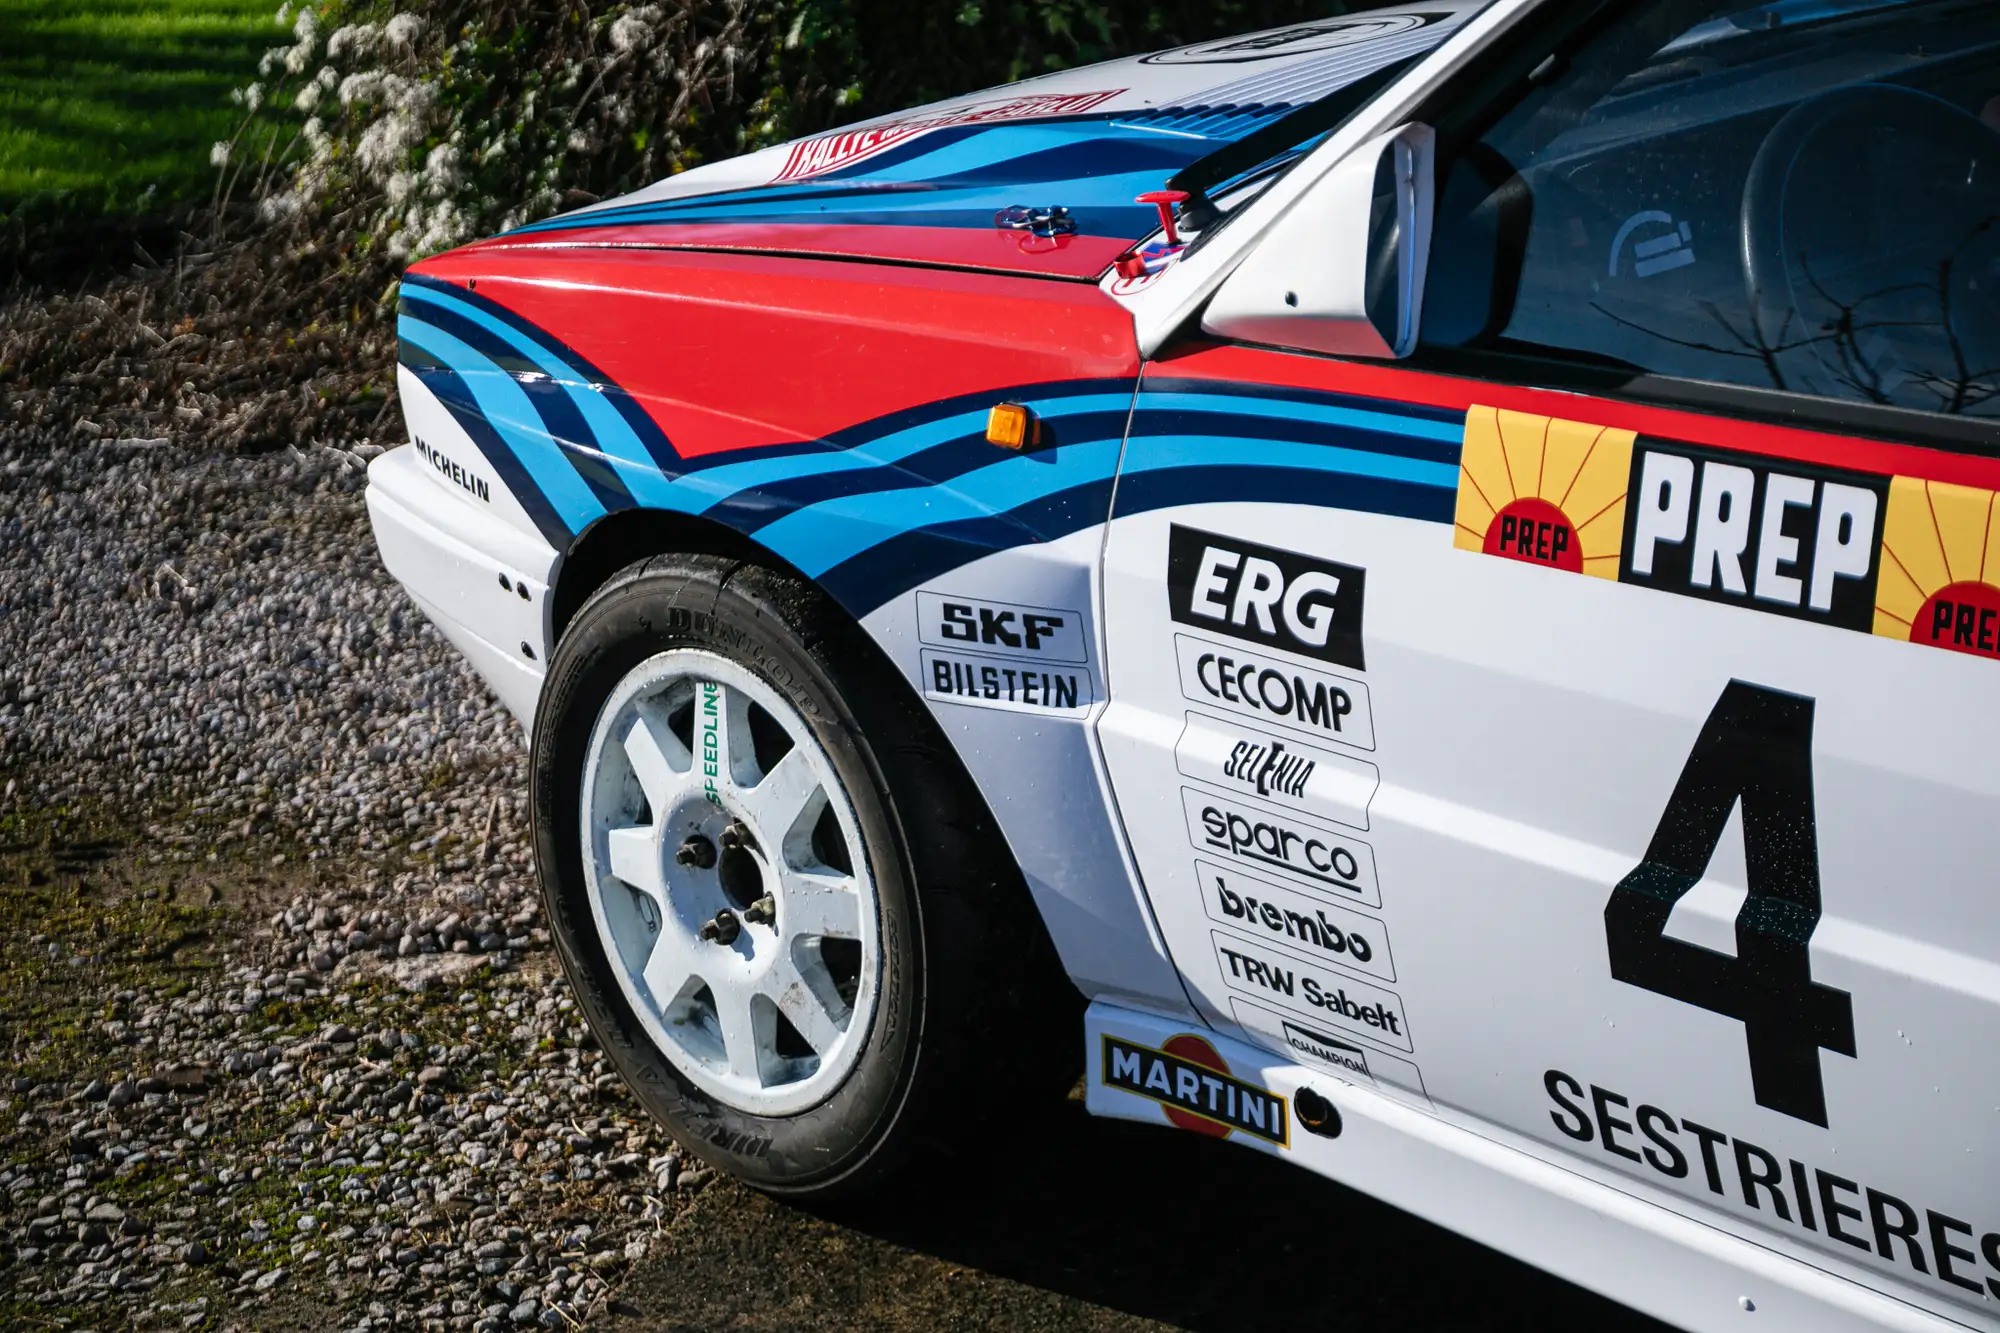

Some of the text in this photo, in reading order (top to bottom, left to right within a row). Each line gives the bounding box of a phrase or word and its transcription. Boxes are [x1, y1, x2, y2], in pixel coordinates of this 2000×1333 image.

[415, 435, 490, 503] MICHELIN
[1499, 515, 1568, 562] PREP
[1631, 451, 1878, 612] PREP
[941, 602, 1065, 651] SKF
[1190, 546, 1340, 648] ERG
[1931, 599, 2000, 653] PRE
[668, 606, 820, 716] DUNLOP
[932, 659, 1078, 709] BILSTEIN
[1197, 653, 1352, 732] CECOMP
[704, 680, 722, 809] SPEEDLINE
[1224, 741, 1316, 798] SELENIA
[1202, 806, 1358, 882] sparco
[1215, 877, 1372, 963] brembo
[1604, 677, 1857, 1129] 4
[1221, 947, 1402, 1036] TRW Sabelt
[1112, 1047, 1280, 1135] MARTINI
[1292, 1038, 1369, 1077] CHAMPION
